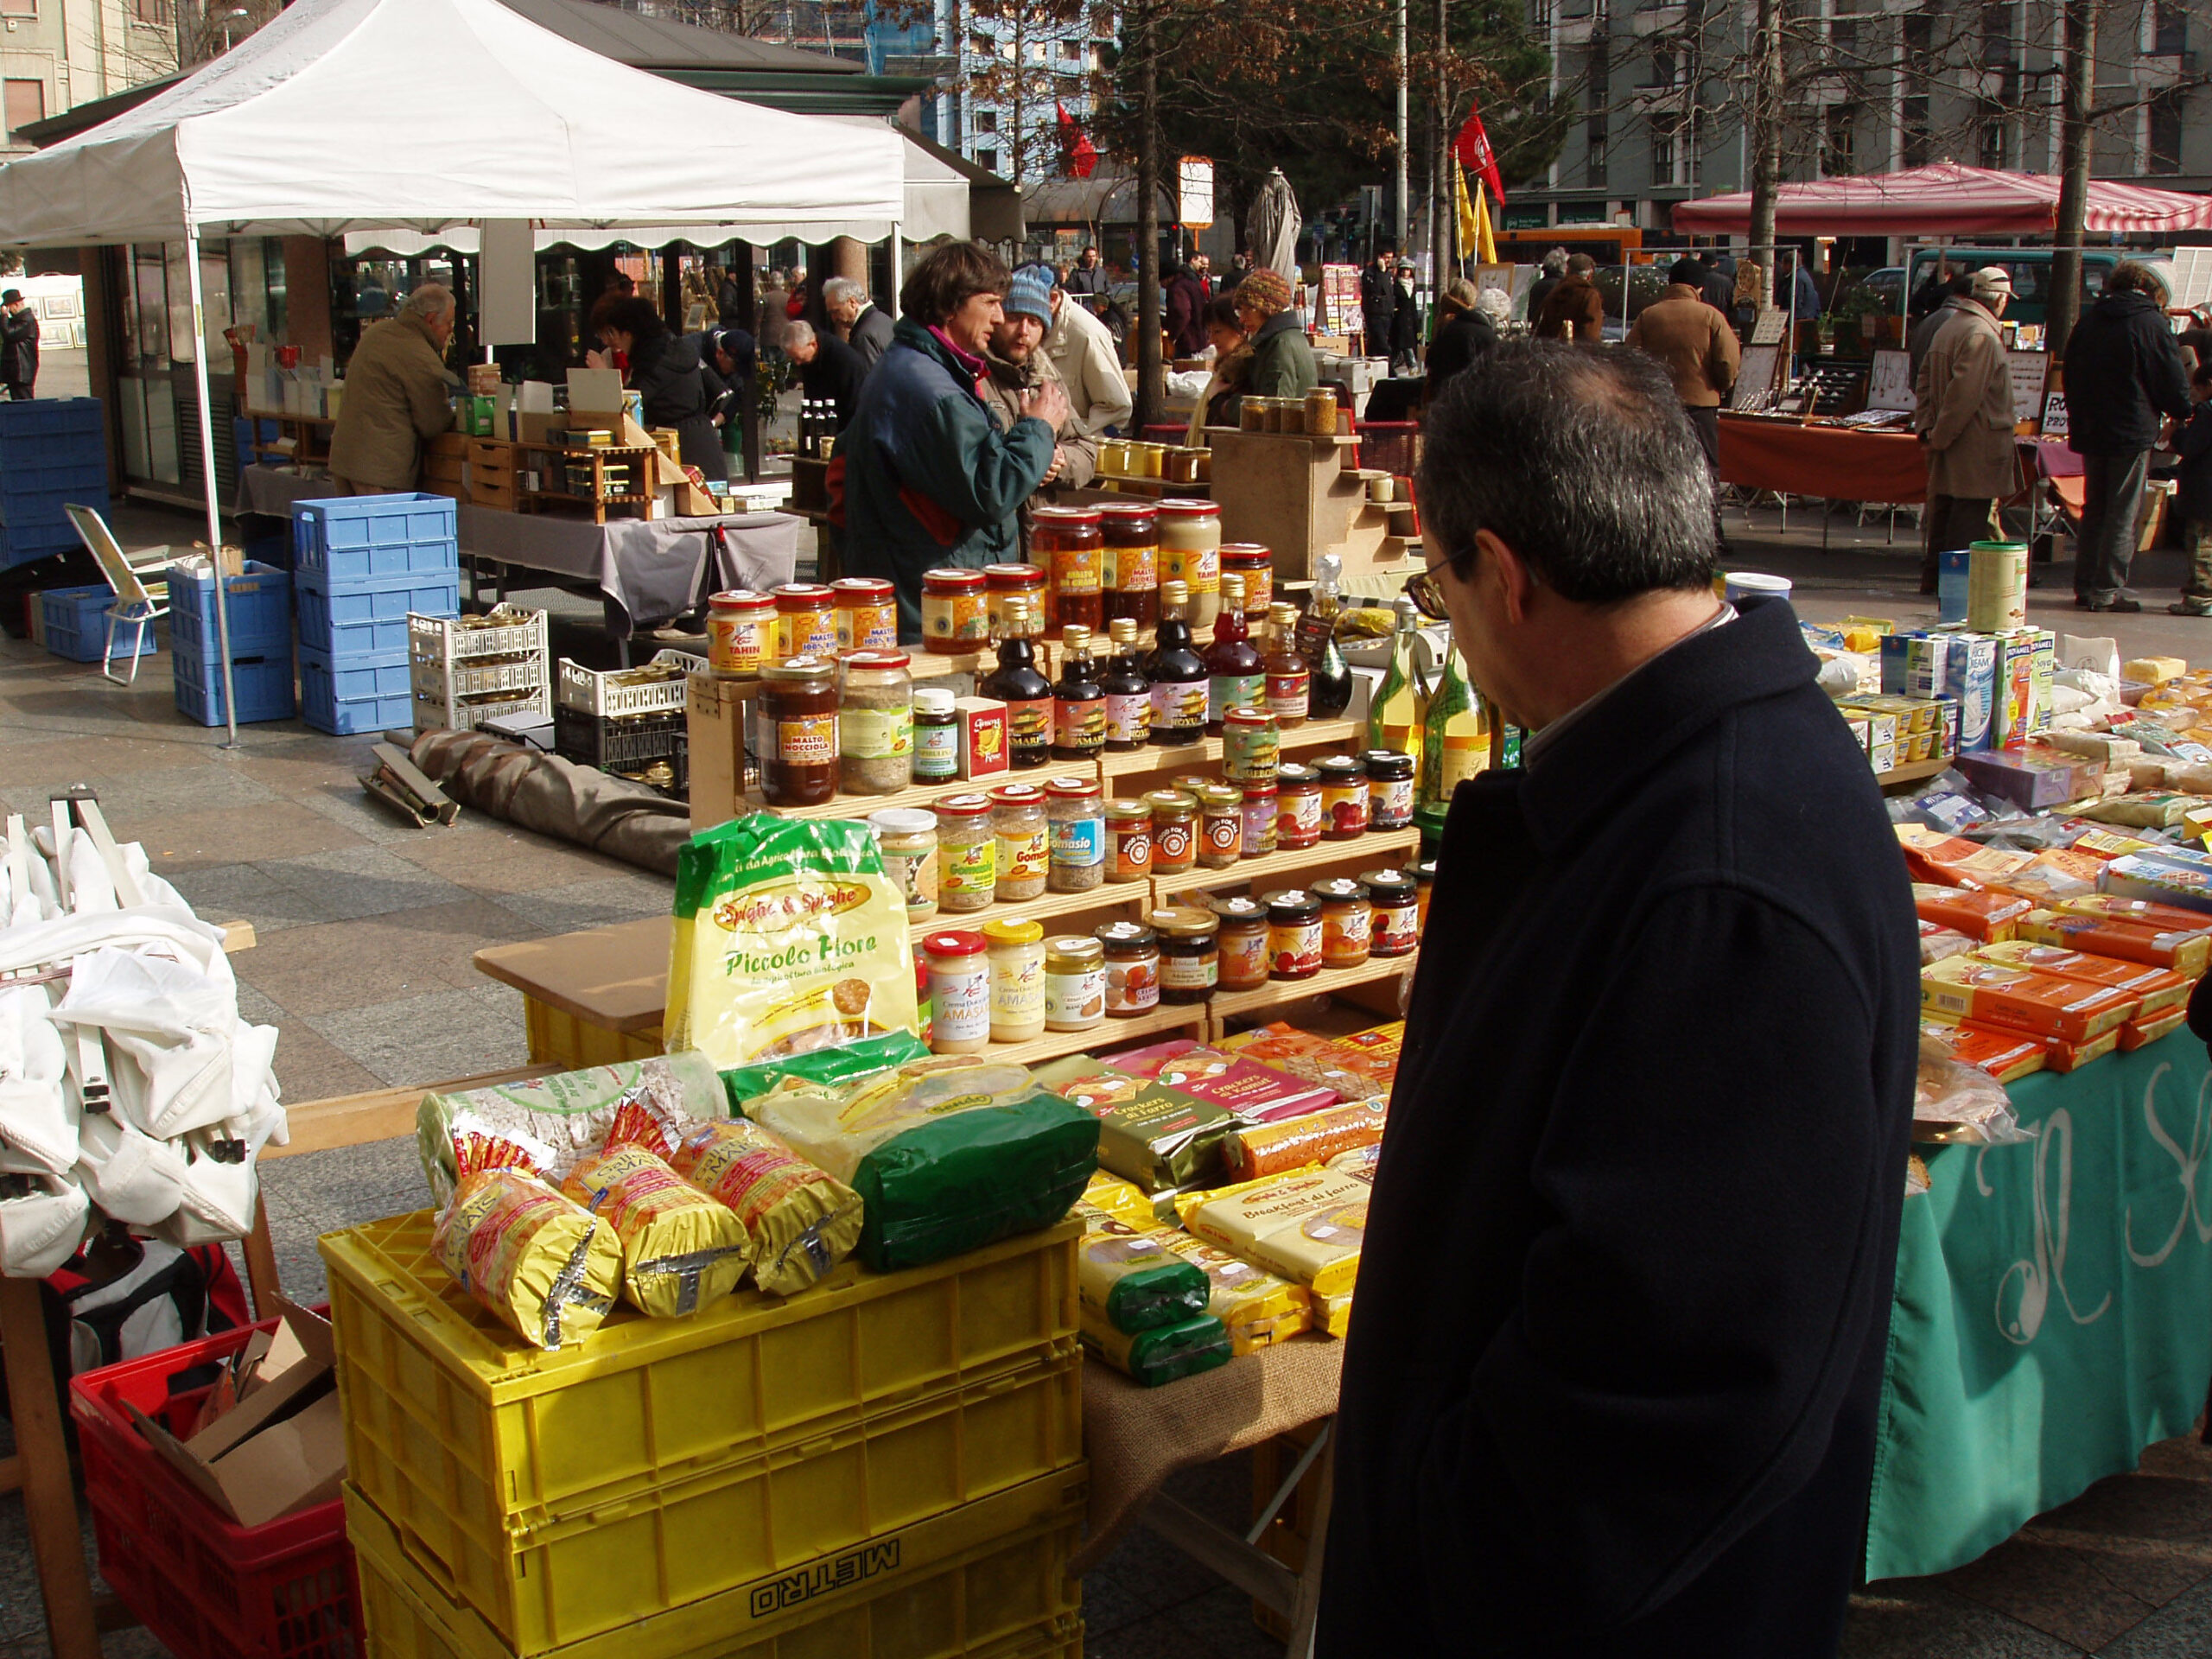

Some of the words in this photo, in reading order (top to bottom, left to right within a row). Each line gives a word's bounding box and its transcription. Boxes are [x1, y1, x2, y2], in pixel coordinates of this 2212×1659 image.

[729, 645, 760, 655] TAHIN
[784, 743, 830, 752] NOCCIOLA
[792, 735, 823, 744] MALTO
[1008, 735, 1039, 746] AMARI
[1207, 819, 1221, 834] FOOD
[1050, 836, 1091, 849] omasio
[1157, 829, 1171, 843] FOOD
[1123, 837, 1136, 853] FOOD
[801, 886, 856, 915] Spighe
[725, 944, 811, 976] Piccolo
[817, 934, 877, 961] Fiore
[1211, 1074, 1261, 1094] Crackers
[1234, 1077, 1273, 1093] Kamut
[1114, 1096, 1165, 1116] Crackers
[1138, 1102, 1173, 1118] Farro
[1243, 1198, 1310, 1219] Breakfast
[1311, 1192, 1325, 1201] di
[1326, 1181, 1359, 1198] farro
[750, 1538, 899, 1619] METRO
